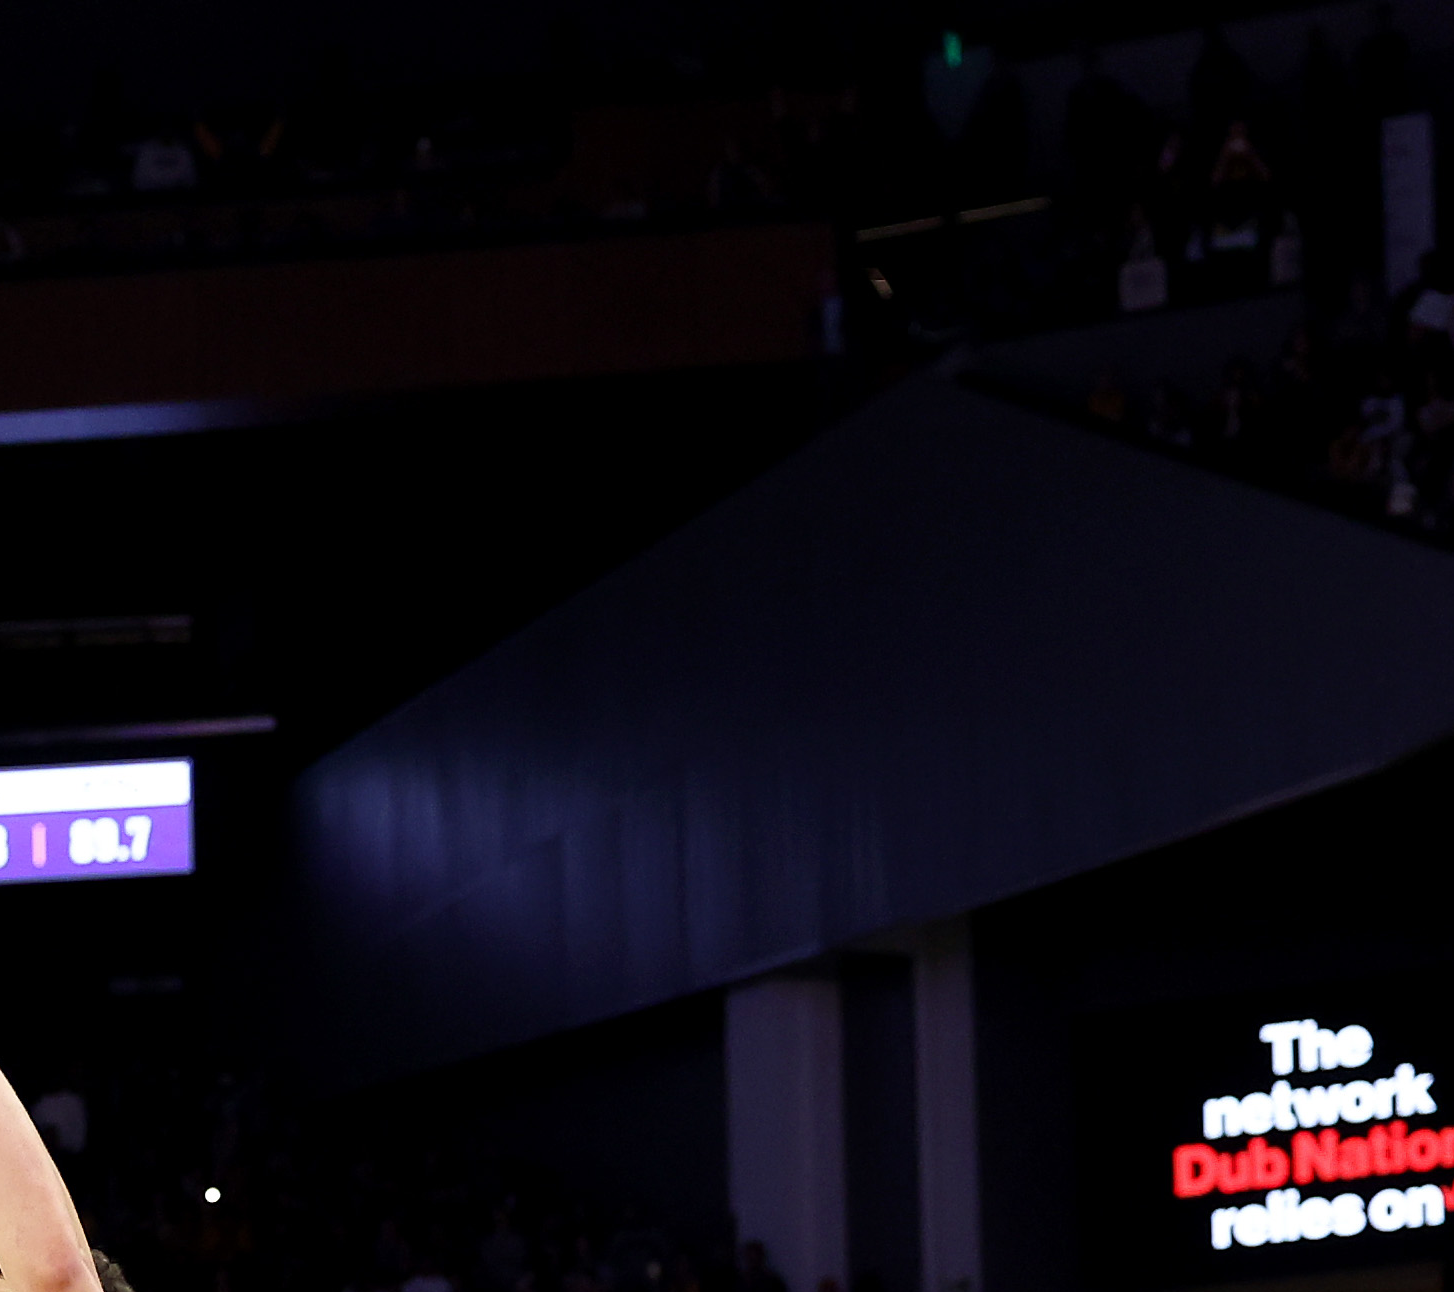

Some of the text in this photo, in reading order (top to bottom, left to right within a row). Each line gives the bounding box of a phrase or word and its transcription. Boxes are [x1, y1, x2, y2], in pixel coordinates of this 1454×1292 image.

[1260, 1019, 1373, 1075] The
[1203, 1063, 1436, 1139] network
[1172, 1139, 1290, 1199] Dub
[1211, 1183, 1446, 1250] relies on
